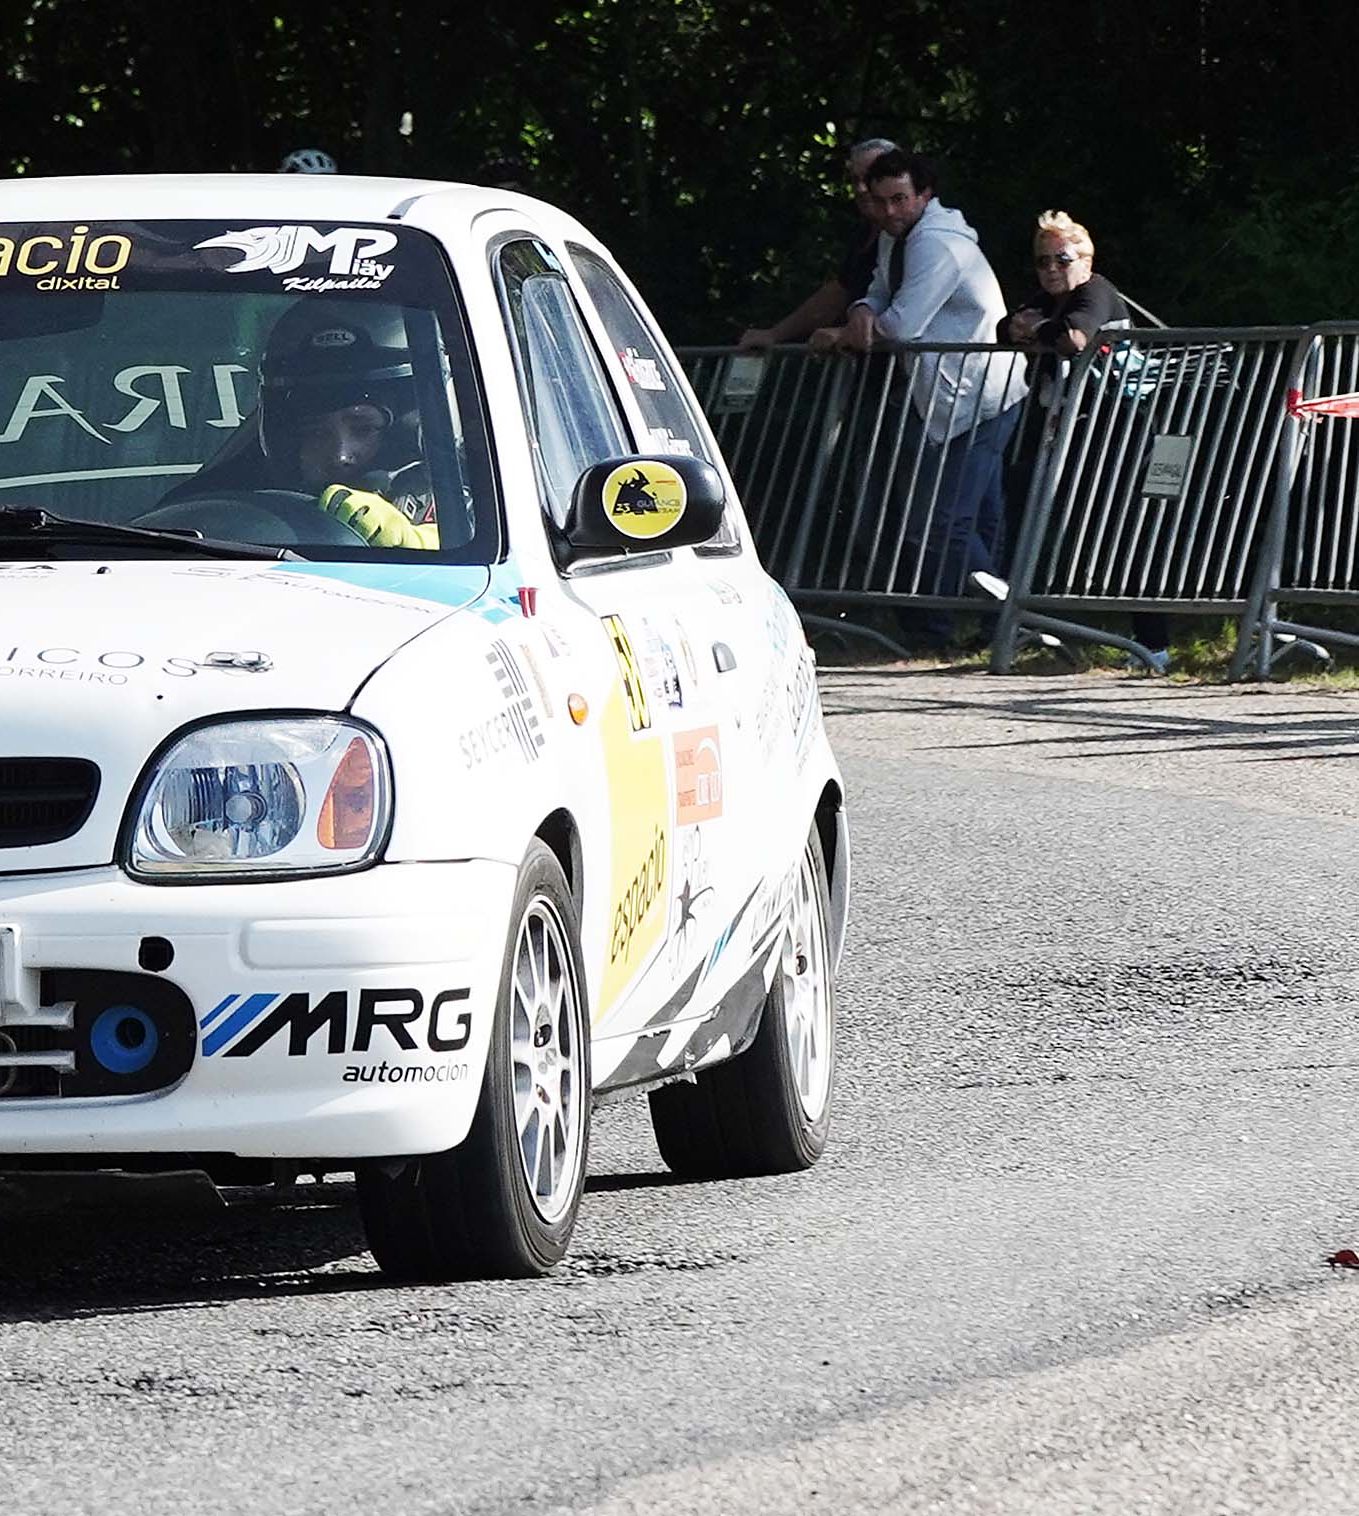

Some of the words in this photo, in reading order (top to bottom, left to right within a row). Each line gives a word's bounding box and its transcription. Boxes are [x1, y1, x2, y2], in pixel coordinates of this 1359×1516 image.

[36, 275, 121, 291] dixital
[611, 823, 665, 965] espacio
[222, 988, 471, 1058] MRG
